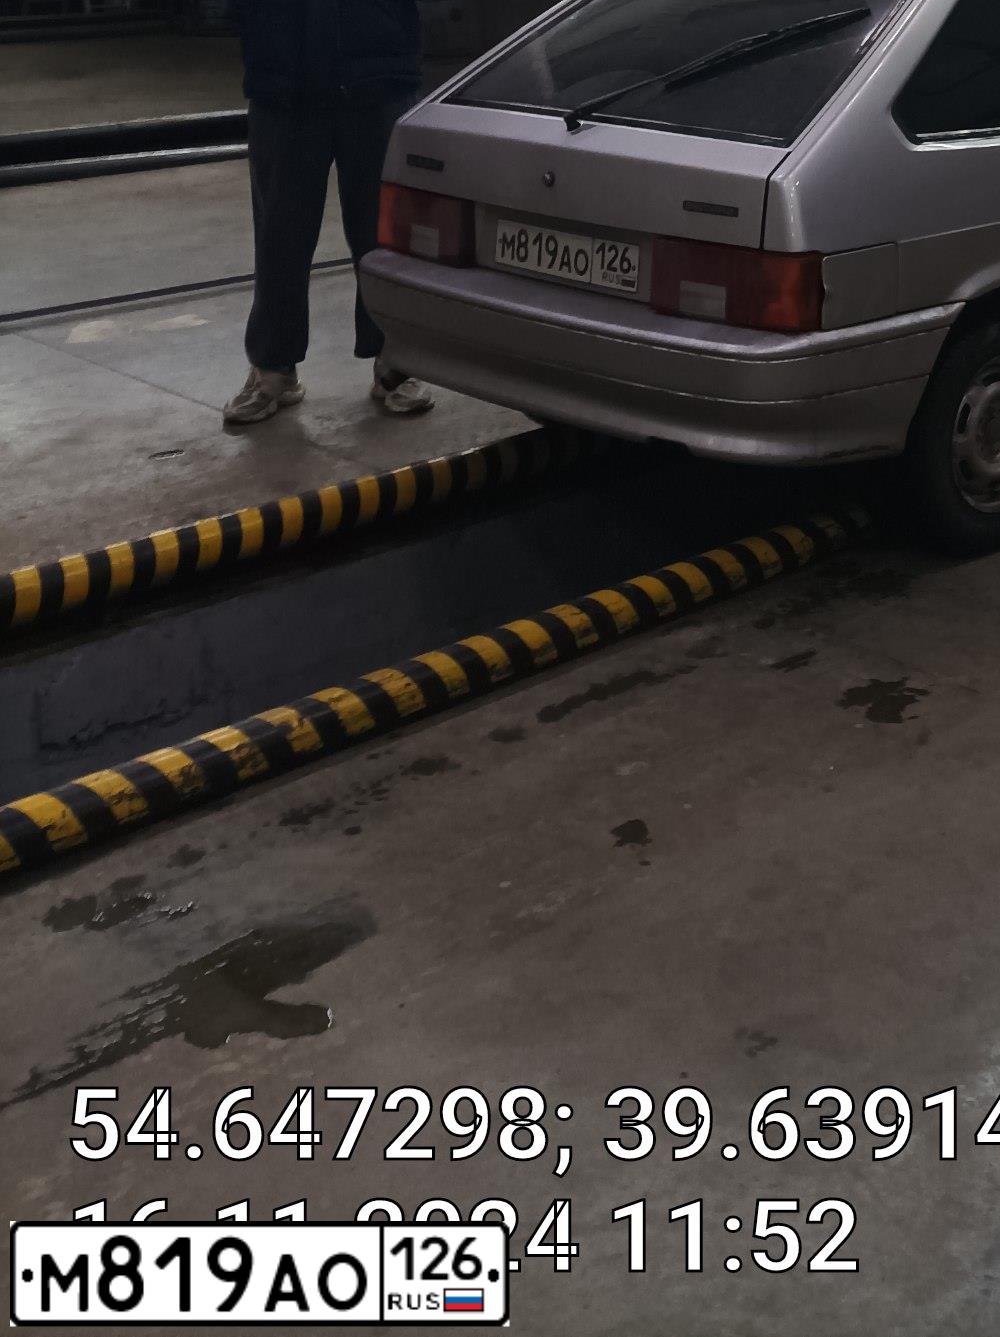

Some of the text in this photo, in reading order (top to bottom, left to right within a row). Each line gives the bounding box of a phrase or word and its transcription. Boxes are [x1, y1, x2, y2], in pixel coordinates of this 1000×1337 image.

[501, 228, 632, 276] М819АО 126
[602, 271, 622, 285] RUS
